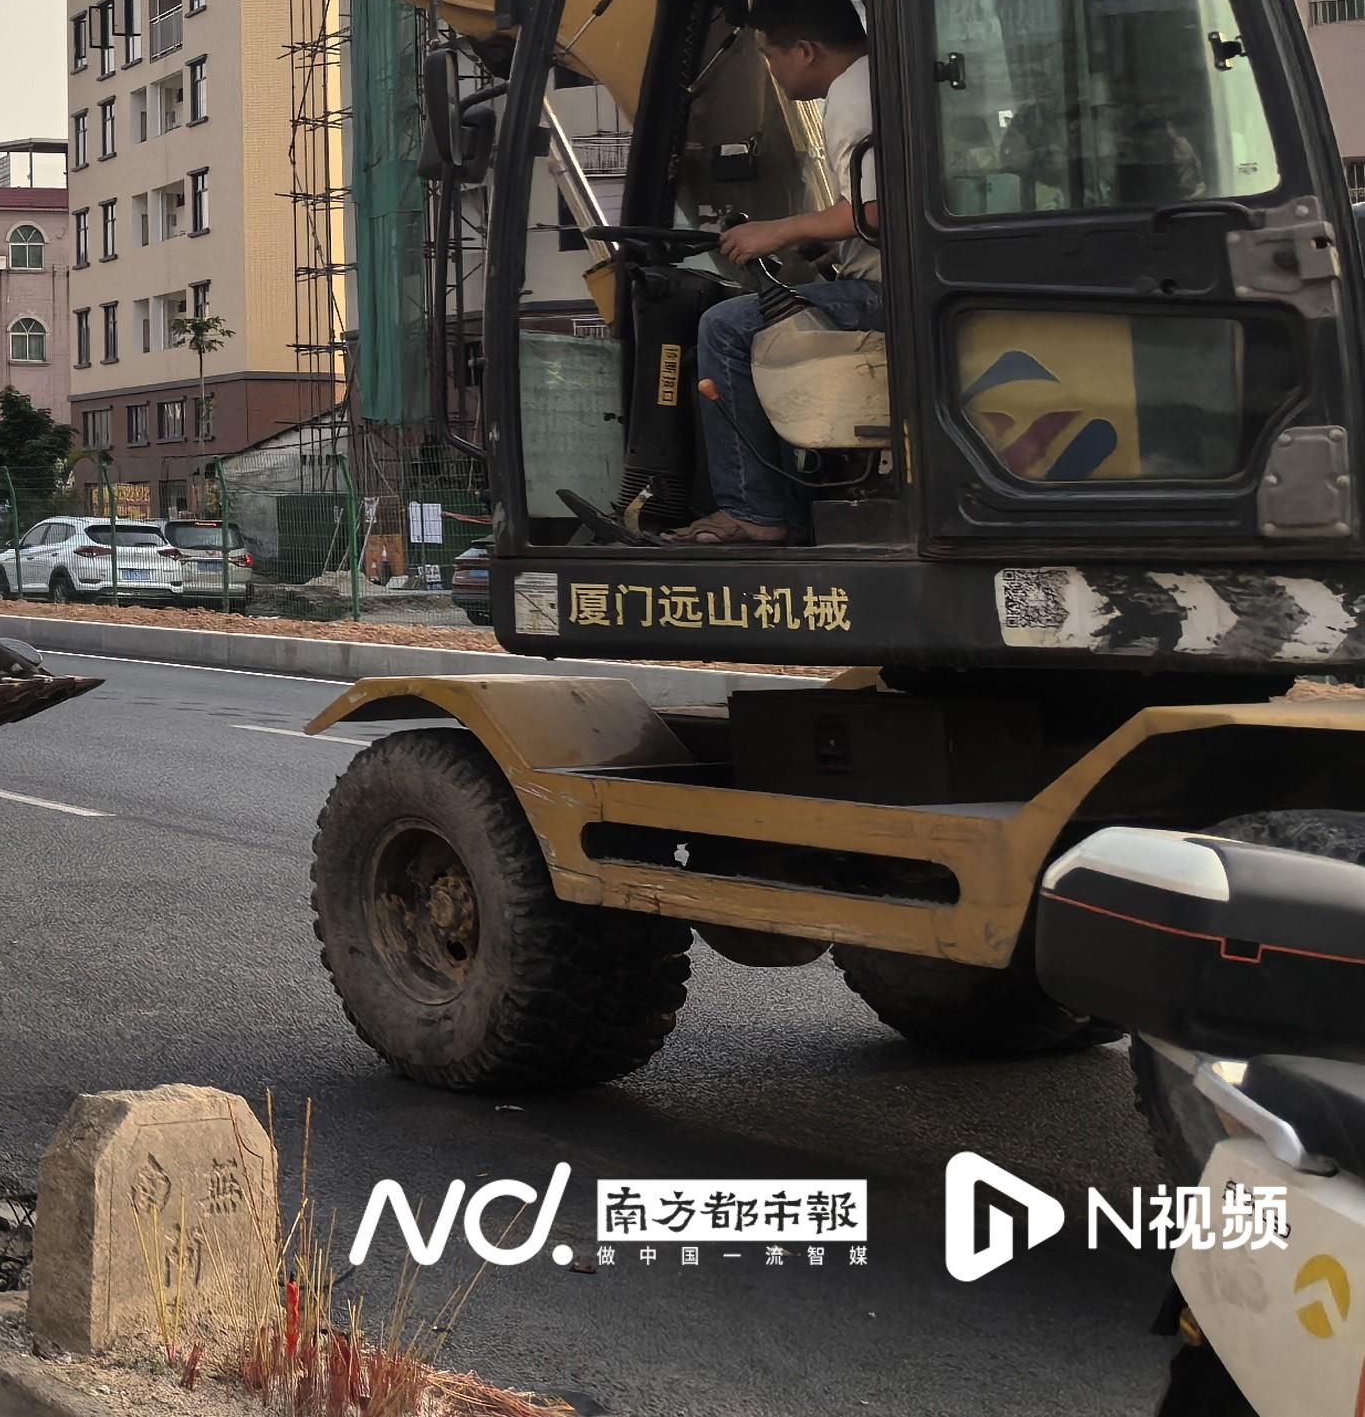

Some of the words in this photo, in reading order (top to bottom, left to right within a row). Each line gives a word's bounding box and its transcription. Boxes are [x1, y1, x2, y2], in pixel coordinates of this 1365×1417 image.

[569, 582, 852, 632] 厦门远山机械
